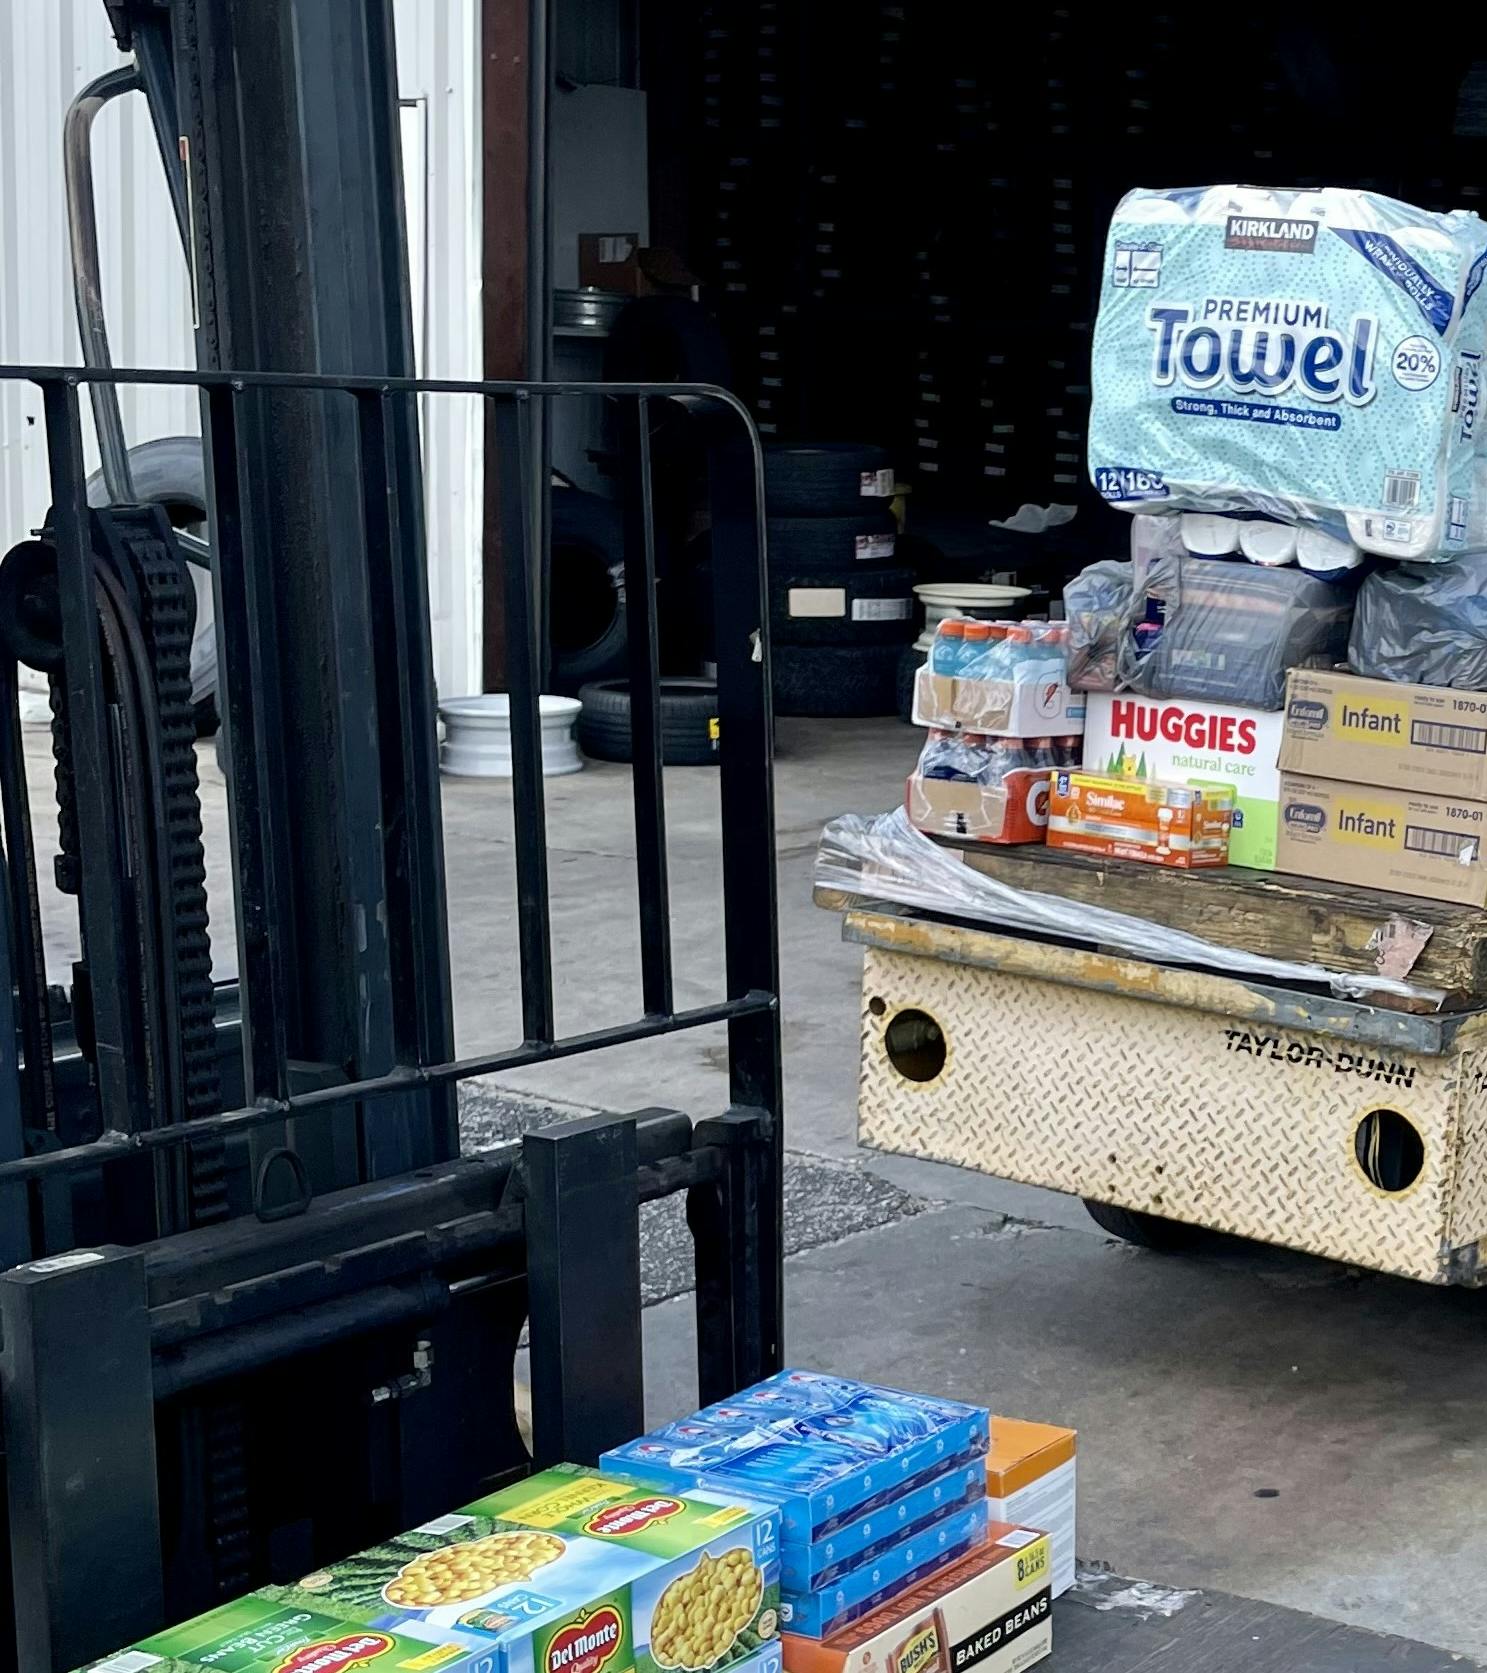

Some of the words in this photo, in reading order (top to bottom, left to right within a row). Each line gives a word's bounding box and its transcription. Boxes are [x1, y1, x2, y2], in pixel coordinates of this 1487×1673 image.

[1230, 219, 1314, 240] KIRKLAND
[1203, 299, 1322, 328] PREMIUM
[1151, 308, 1372, 398] Towel
[1396, 352, 1436, 373] 20%
[1175, 399, 1217, 417] Strong,
[1221, 403, 1250, 417] Thick
[1252, 408, 1271, 419] and
[1273, 409, 1337, 428] Absorbent
[1099, 472, 1120, 491] 12
[1111, 699, 1257, 755] HUGGIES
[1342, 704, 1401, 734] Infant
[1172, 753, 1222, 772] natural
[1225, 760, 1256, 776] care
[1338, 809, 1396, 839] Infant
[1446, 806, 1483, 822] 1870-01
[640, 1499, 674, 1516] Del
[595, 1509, 644, 1535] Monte
[755, 1519, 775, 1546] 12
[757, 1543, 776, 1559] CANS
[1016, 1558, 1025, 1582] 8
[1024, 1555, 1046, 1578] CANS
[511, 1597, 554, 1615] 12
[254, 1612, 313, 1637] GREEN
[955, 1626, 1002, 1666] BAKED
[1004, 1596, 1049, 1636] BEANS
[199, 1635, 256, 1664] BEANS
[247, 1632, 286, 1654] CUT
[341, 1636, 383, 1654] Del
[550, 1644, 574, 1671] Del
[574, 1621, 618, 1658] Monte
[899, 1630, 936, 1673] BUSH'S
[474, 1656, 494, 1673] 12
[762, 1657, 779, 1673] 12
